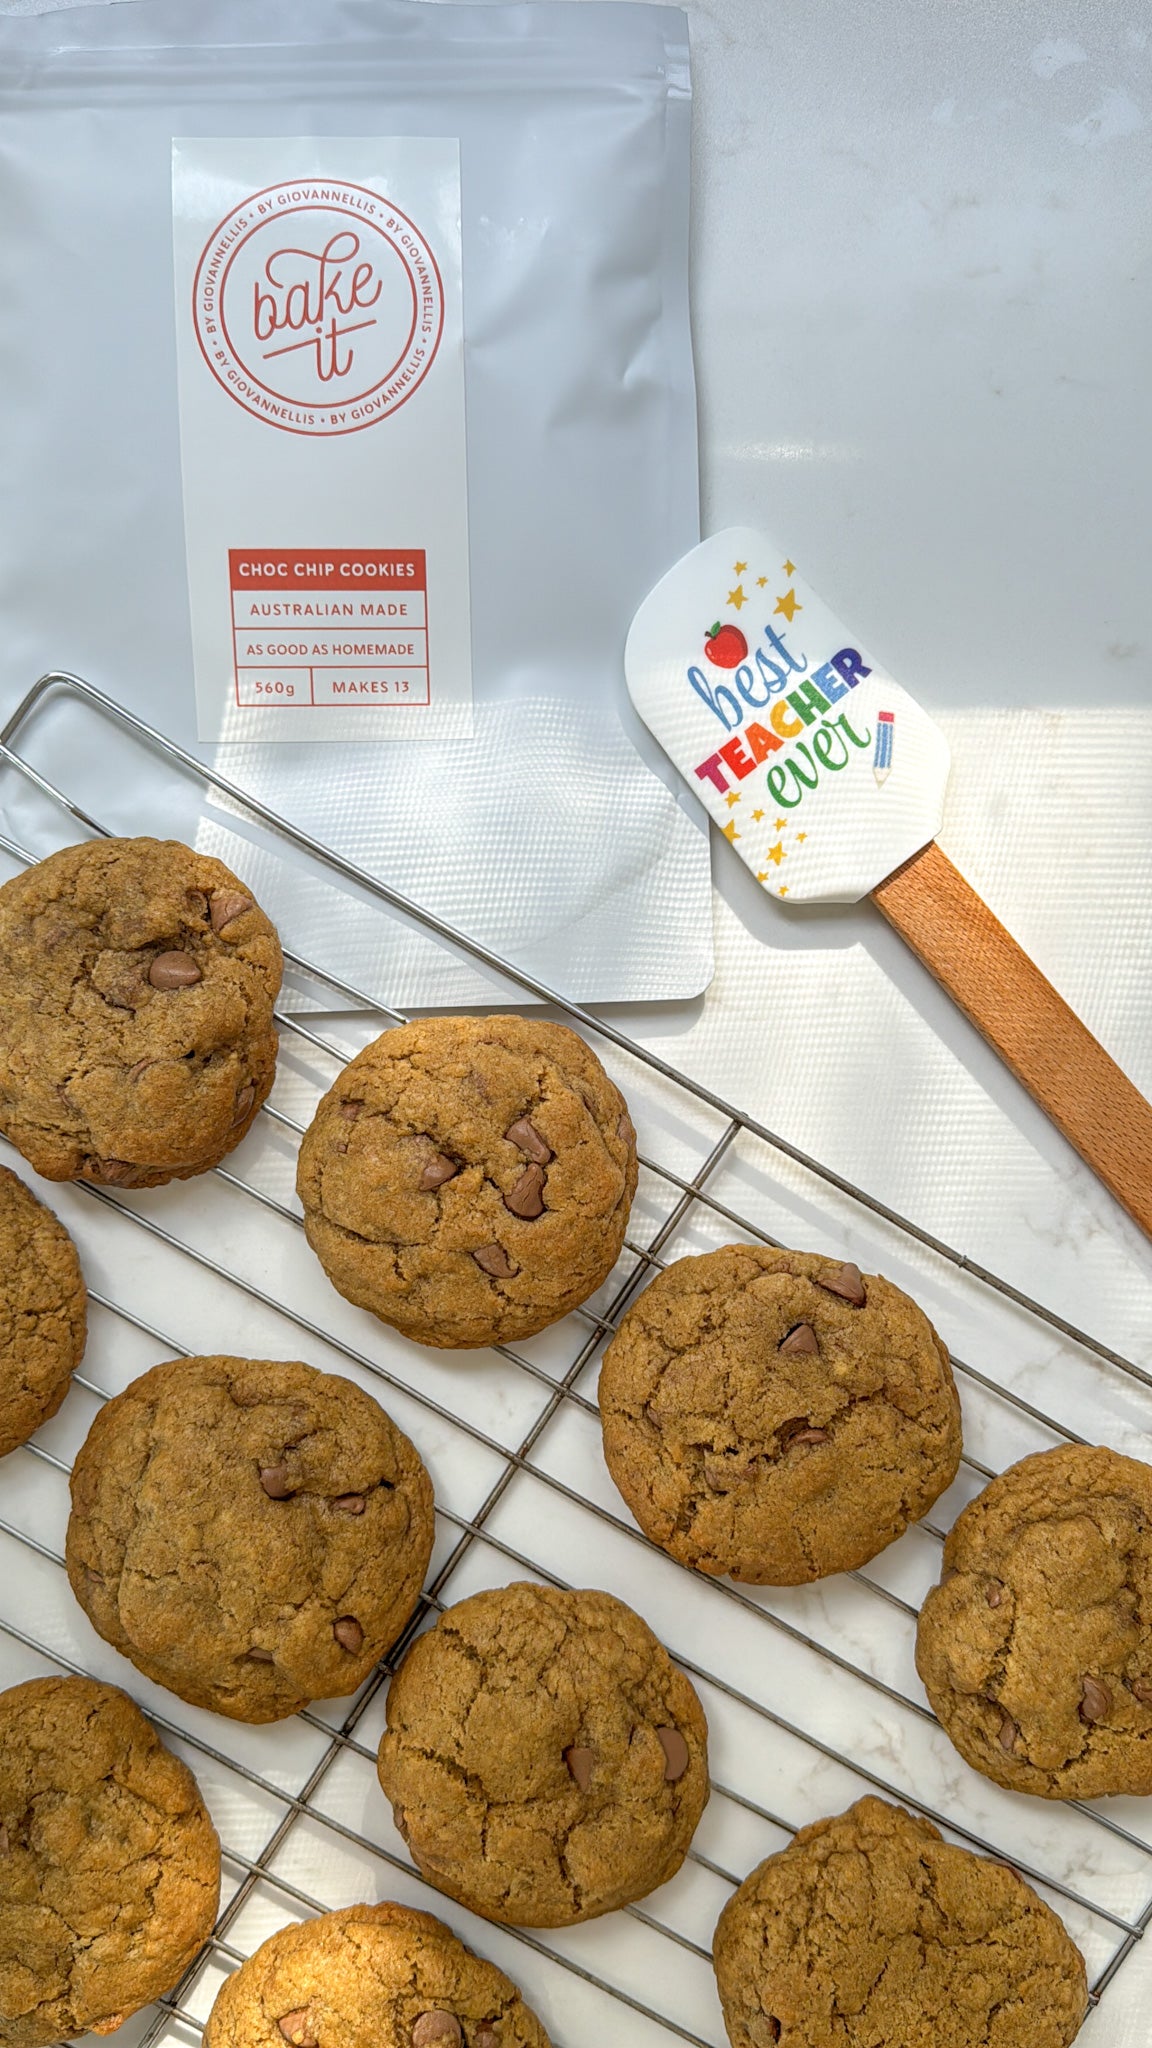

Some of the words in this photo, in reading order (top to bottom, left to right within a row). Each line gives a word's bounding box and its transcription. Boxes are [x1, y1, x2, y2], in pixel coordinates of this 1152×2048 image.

[257, 199, 274, 215] BY
[277, 190, 377, 215] GIOVANNELLIS
[203, 218, 249, 312] GIOVANNELLIS
[254, 231, 383, 341] bake
[385, 218, 403, 234] BY
[400, 233, 434, 334] GIOVANNELLIS
[205, 316, 217, 334] BY
[262, 317, 377, 382] it
[214, 350, 230, 367] BY
[227, 369, 315, 425] GIOVANNELLIS
[330, 412, 347, 425] BY
[351, 348, 426, 421] GIOVANNELLIS
[238, 562, 288, 577] CHOC
[293, 562, 335, 577] CHIP
[339, 562, 415, 577] COOKIES
[250, 603, 354, 616] AUSTRALIAN
[360, 603, 408, 616] MADE
[246, 643, 263, 655] AS
[267, 643, 308, 655] GOOD
[311, 643, 329, 655] AS
[332, 643, 415, 655] HOMEMADE
[687, 624, 808, 732] best
[255, 681, 295, 697] 560g
[332, 681, 389, 693] MAKES
[394, 681, 410, 693] 13
[694, 647, 873, 794] TEACHER
[766, 712, 872, 809] ever
